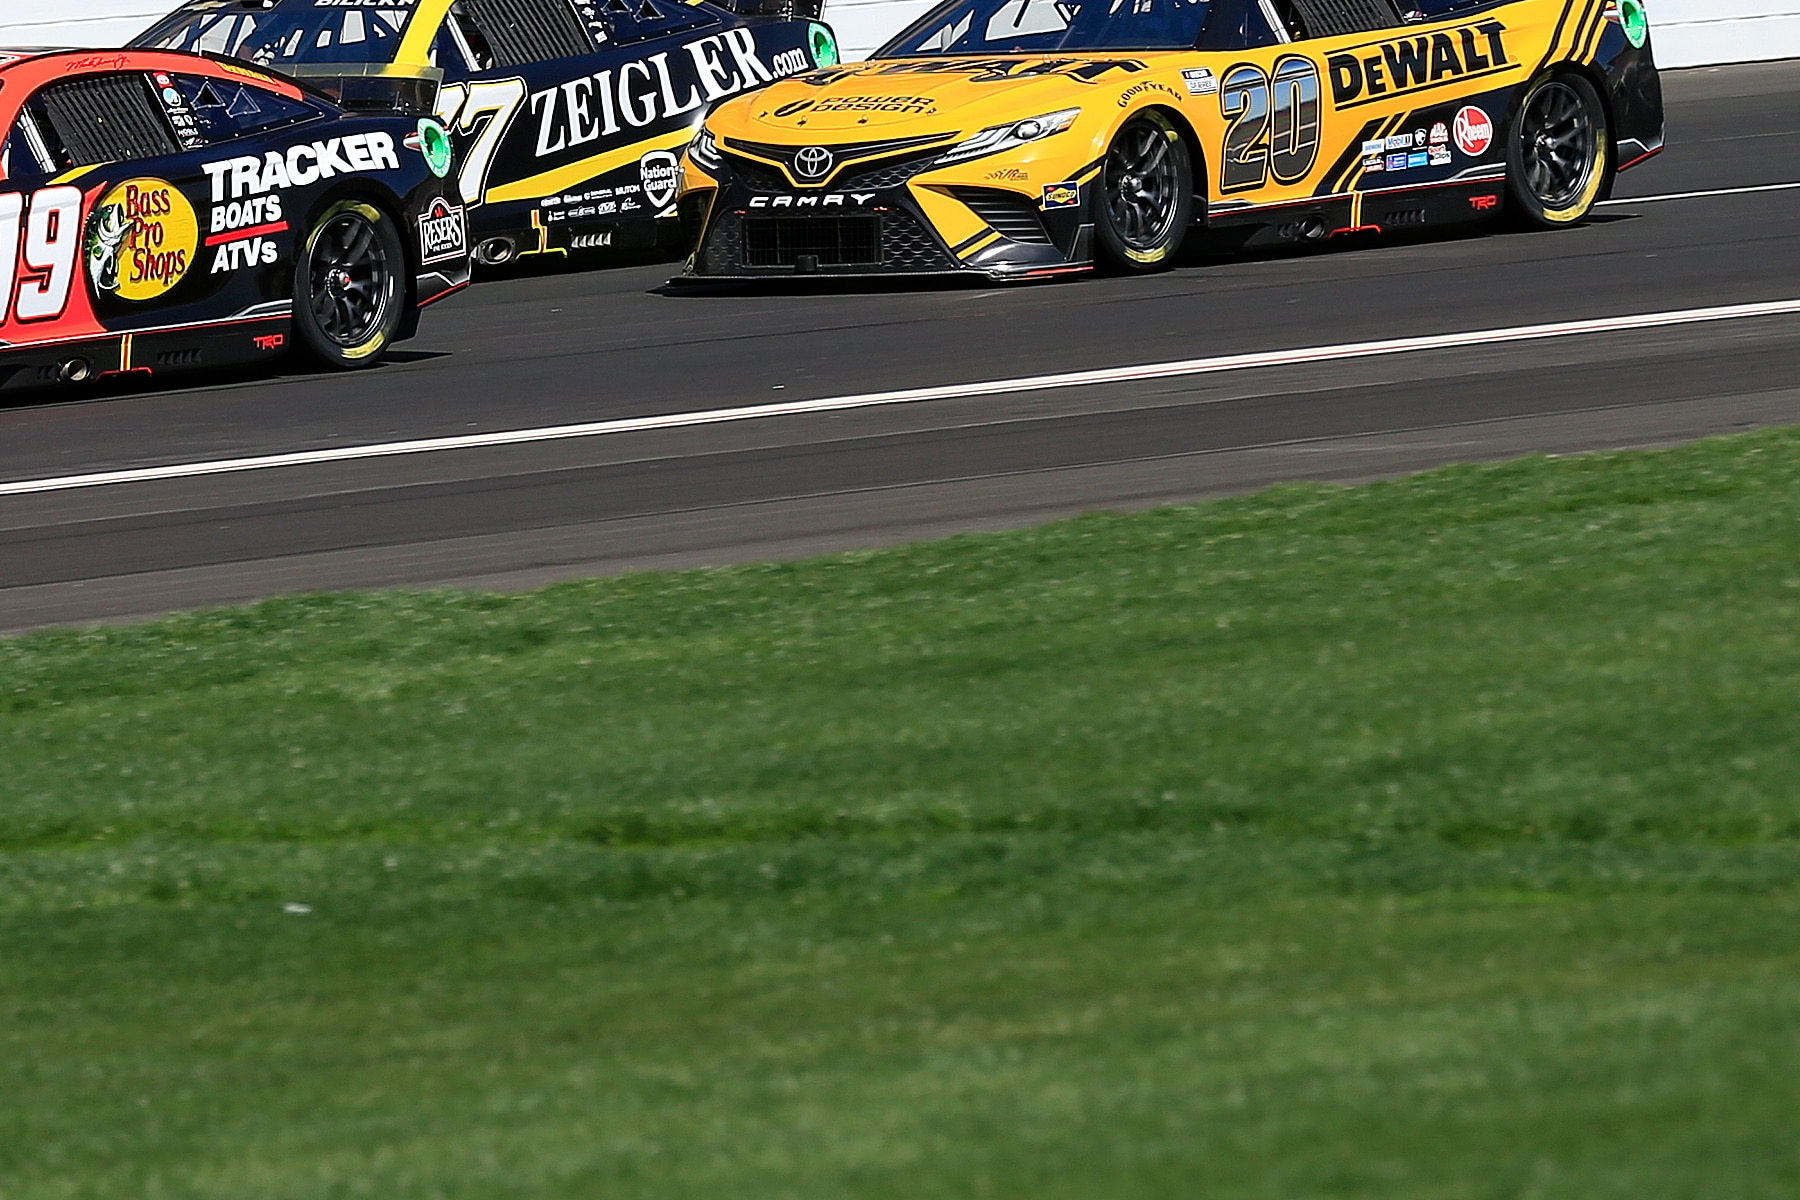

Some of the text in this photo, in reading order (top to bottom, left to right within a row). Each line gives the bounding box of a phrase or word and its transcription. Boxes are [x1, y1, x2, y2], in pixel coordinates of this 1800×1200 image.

[1220, 54, 1321, 194] 20
[1456, 109, 1491, 149] Rheem
[200, 131, 400, 203] TRACKER
[643, 178, 677, 192] Guard
[126, 184, 171, 219] Bass
[210, 194, 283, 233] BOATS
[748, 193, 876, 208] CAMRY
[1469, 195, 1497, 211] TRD
[129, 217, 164, 251] Pro
[129, 247, 188, 287] Shops
[210, 236, 278, 274] ATVs
[252, 333, 284, 350] TRD
